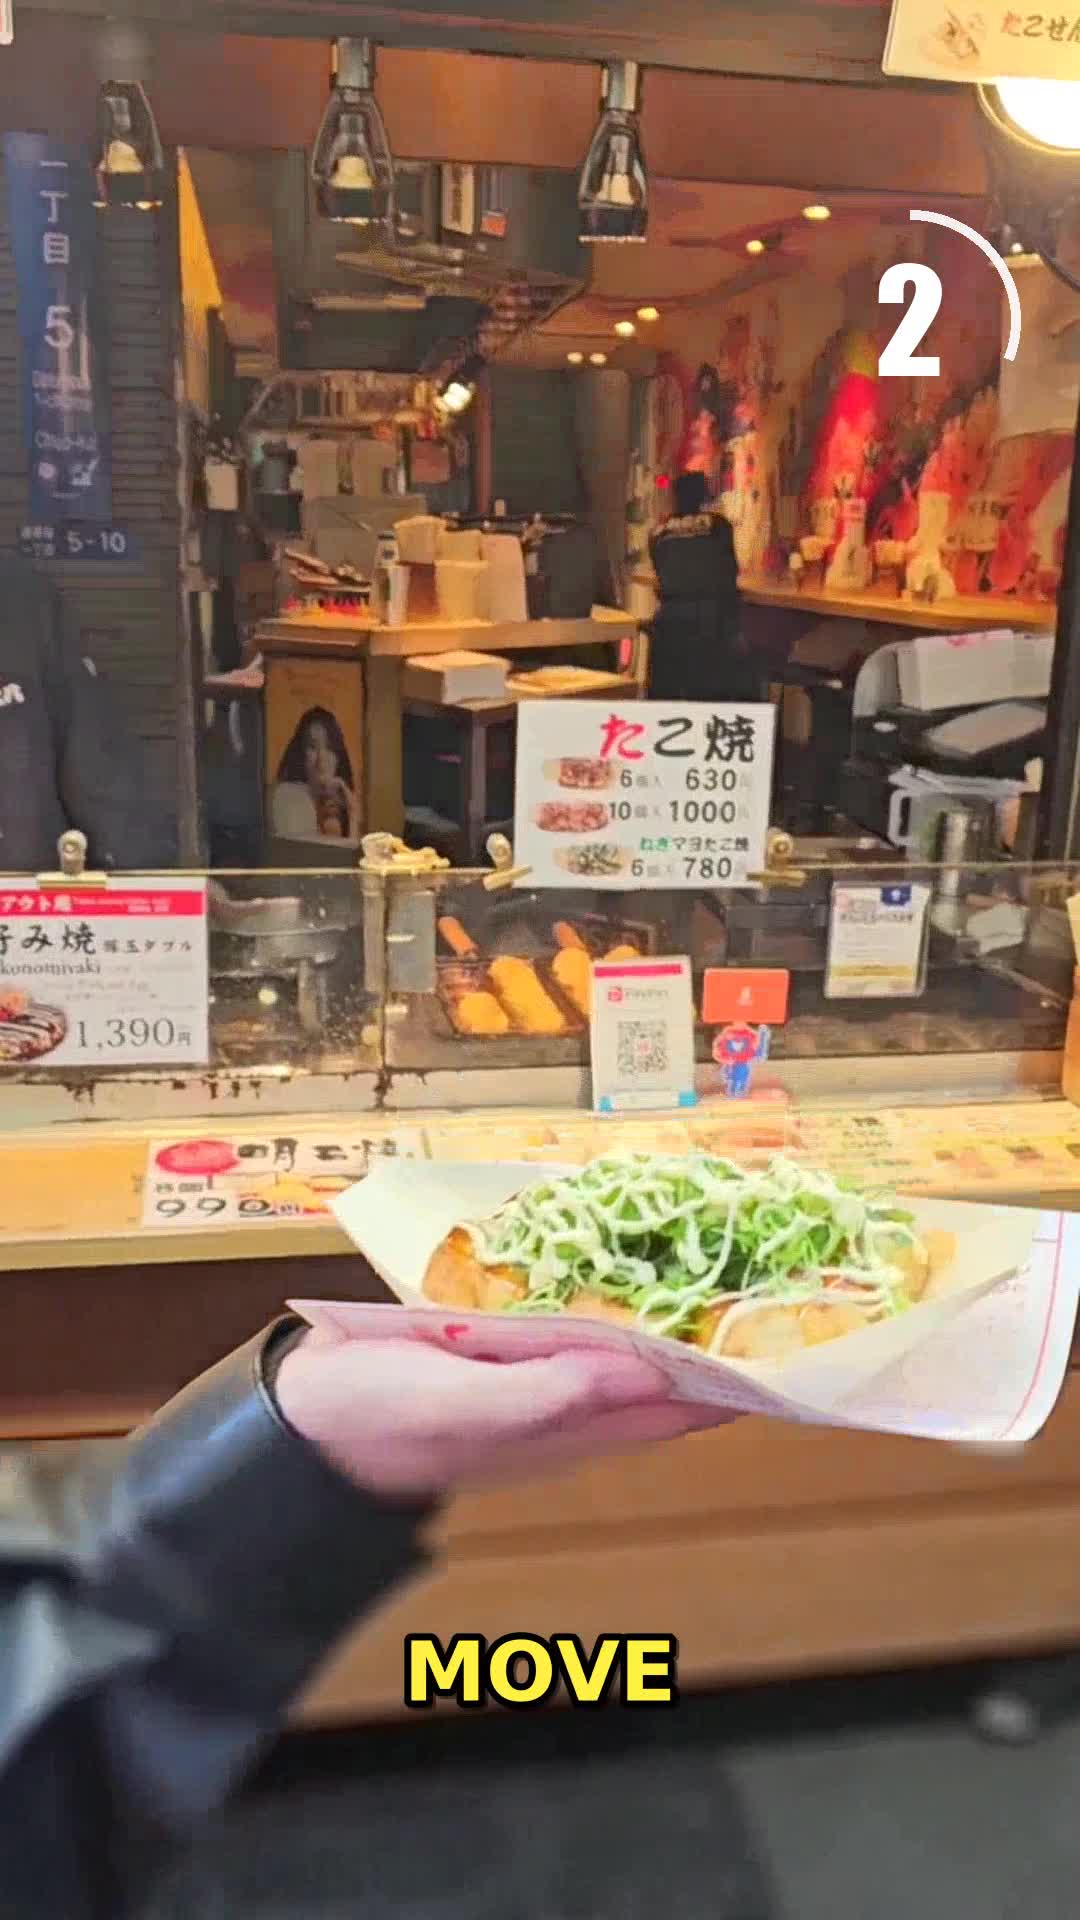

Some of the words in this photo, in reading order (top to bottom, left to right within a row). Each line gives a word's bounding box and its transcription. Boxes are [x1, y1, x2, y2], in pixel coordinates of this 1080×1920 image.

[39, 160, 70, 265] 一丁目
[44, 305, 74, 350] 5
[66, 530, 127, 553] 5-10
[600, 713, 755, 762] たこ焼
[685, 768, 753, 792] 630
[669, 800, 750, 822] 1000
[682, 857, 748, 879] 780
[77, 1017, 192, 1051] 1,390円
